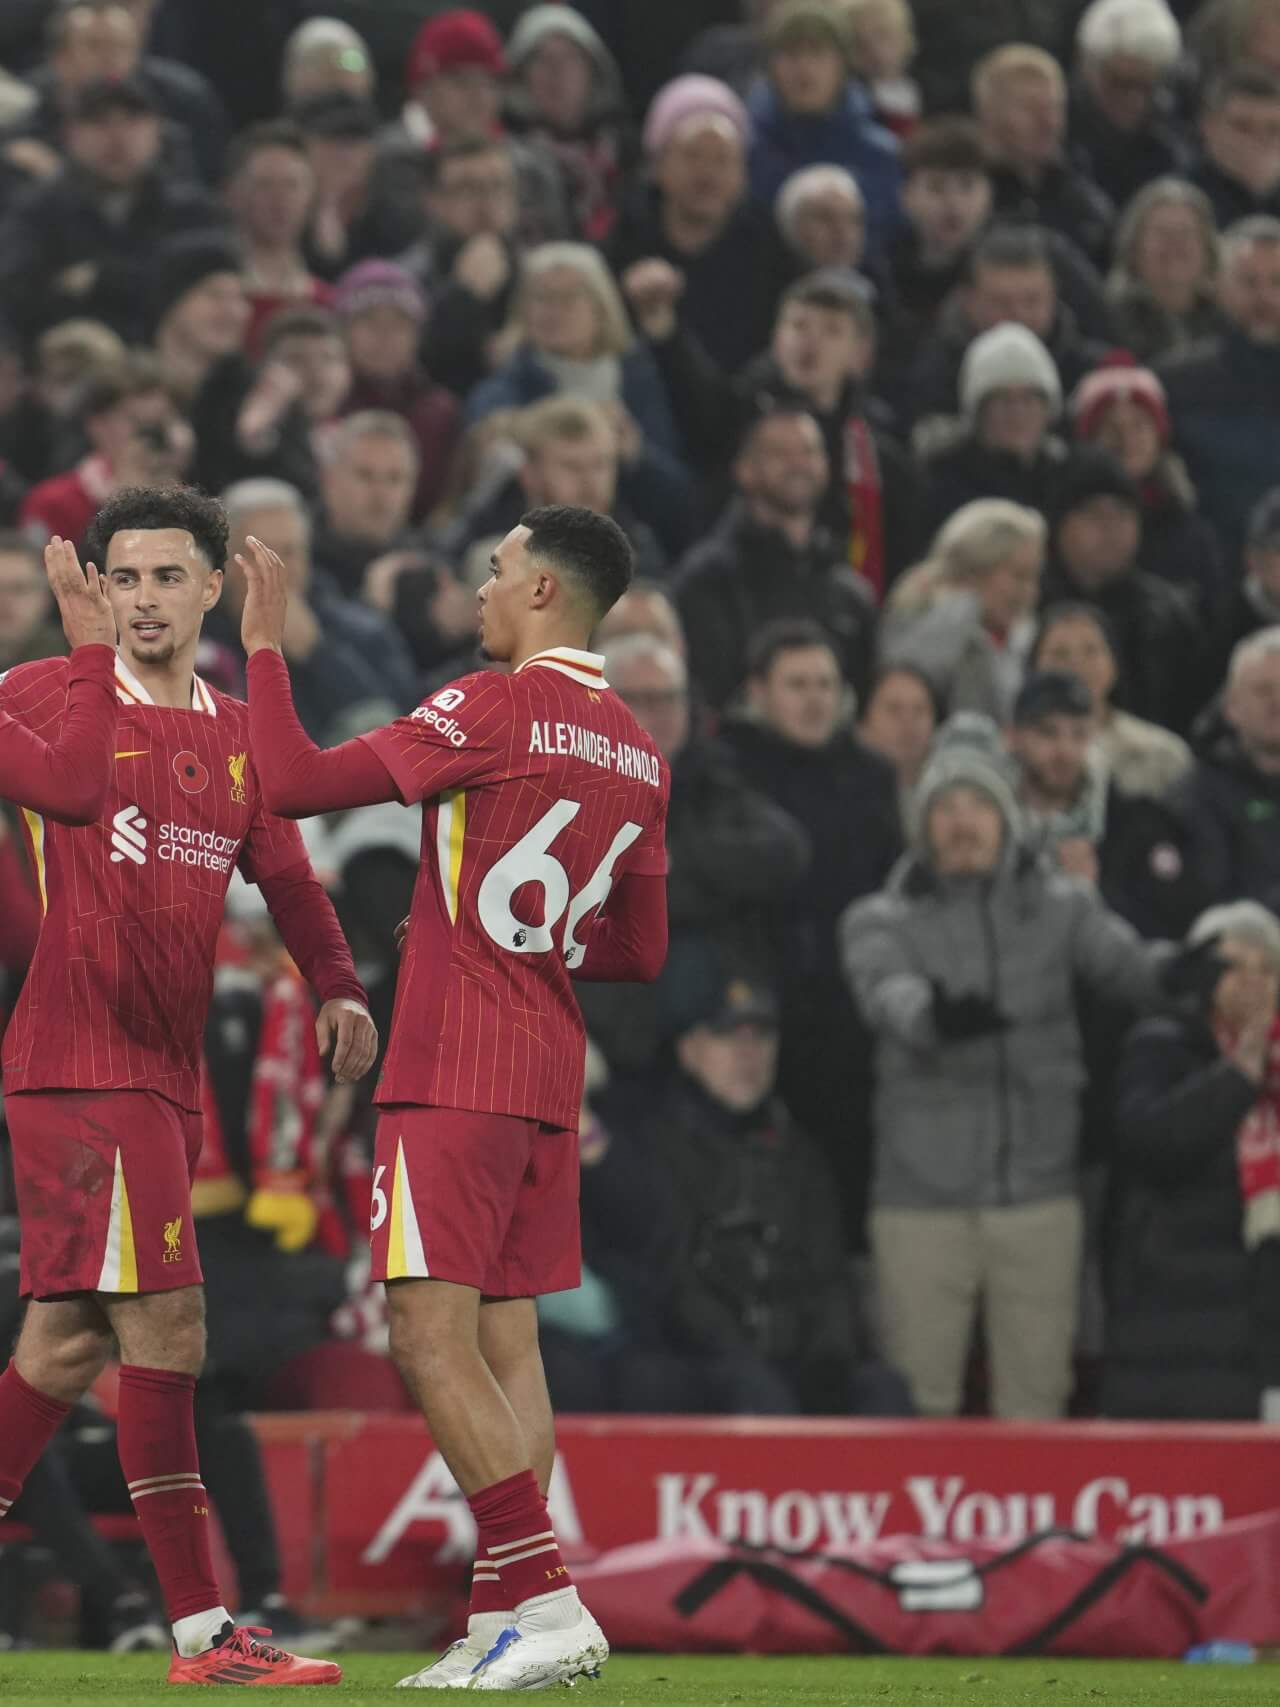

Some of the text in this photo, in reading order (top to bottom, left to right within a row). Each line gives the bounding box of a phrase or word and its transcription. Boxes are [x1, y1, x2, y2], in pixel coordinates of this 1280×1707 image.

[528, 720, 660, 787] ALEXANDER-ARNOLD
[158, 821, 241, 855] standard
[478, 797, 645, 969] 66
[369, 1165, 388, 1232] 6
[162, 1252, 183, 1263] LFC
[656, 1472, 1224, 1553] Know You Can
